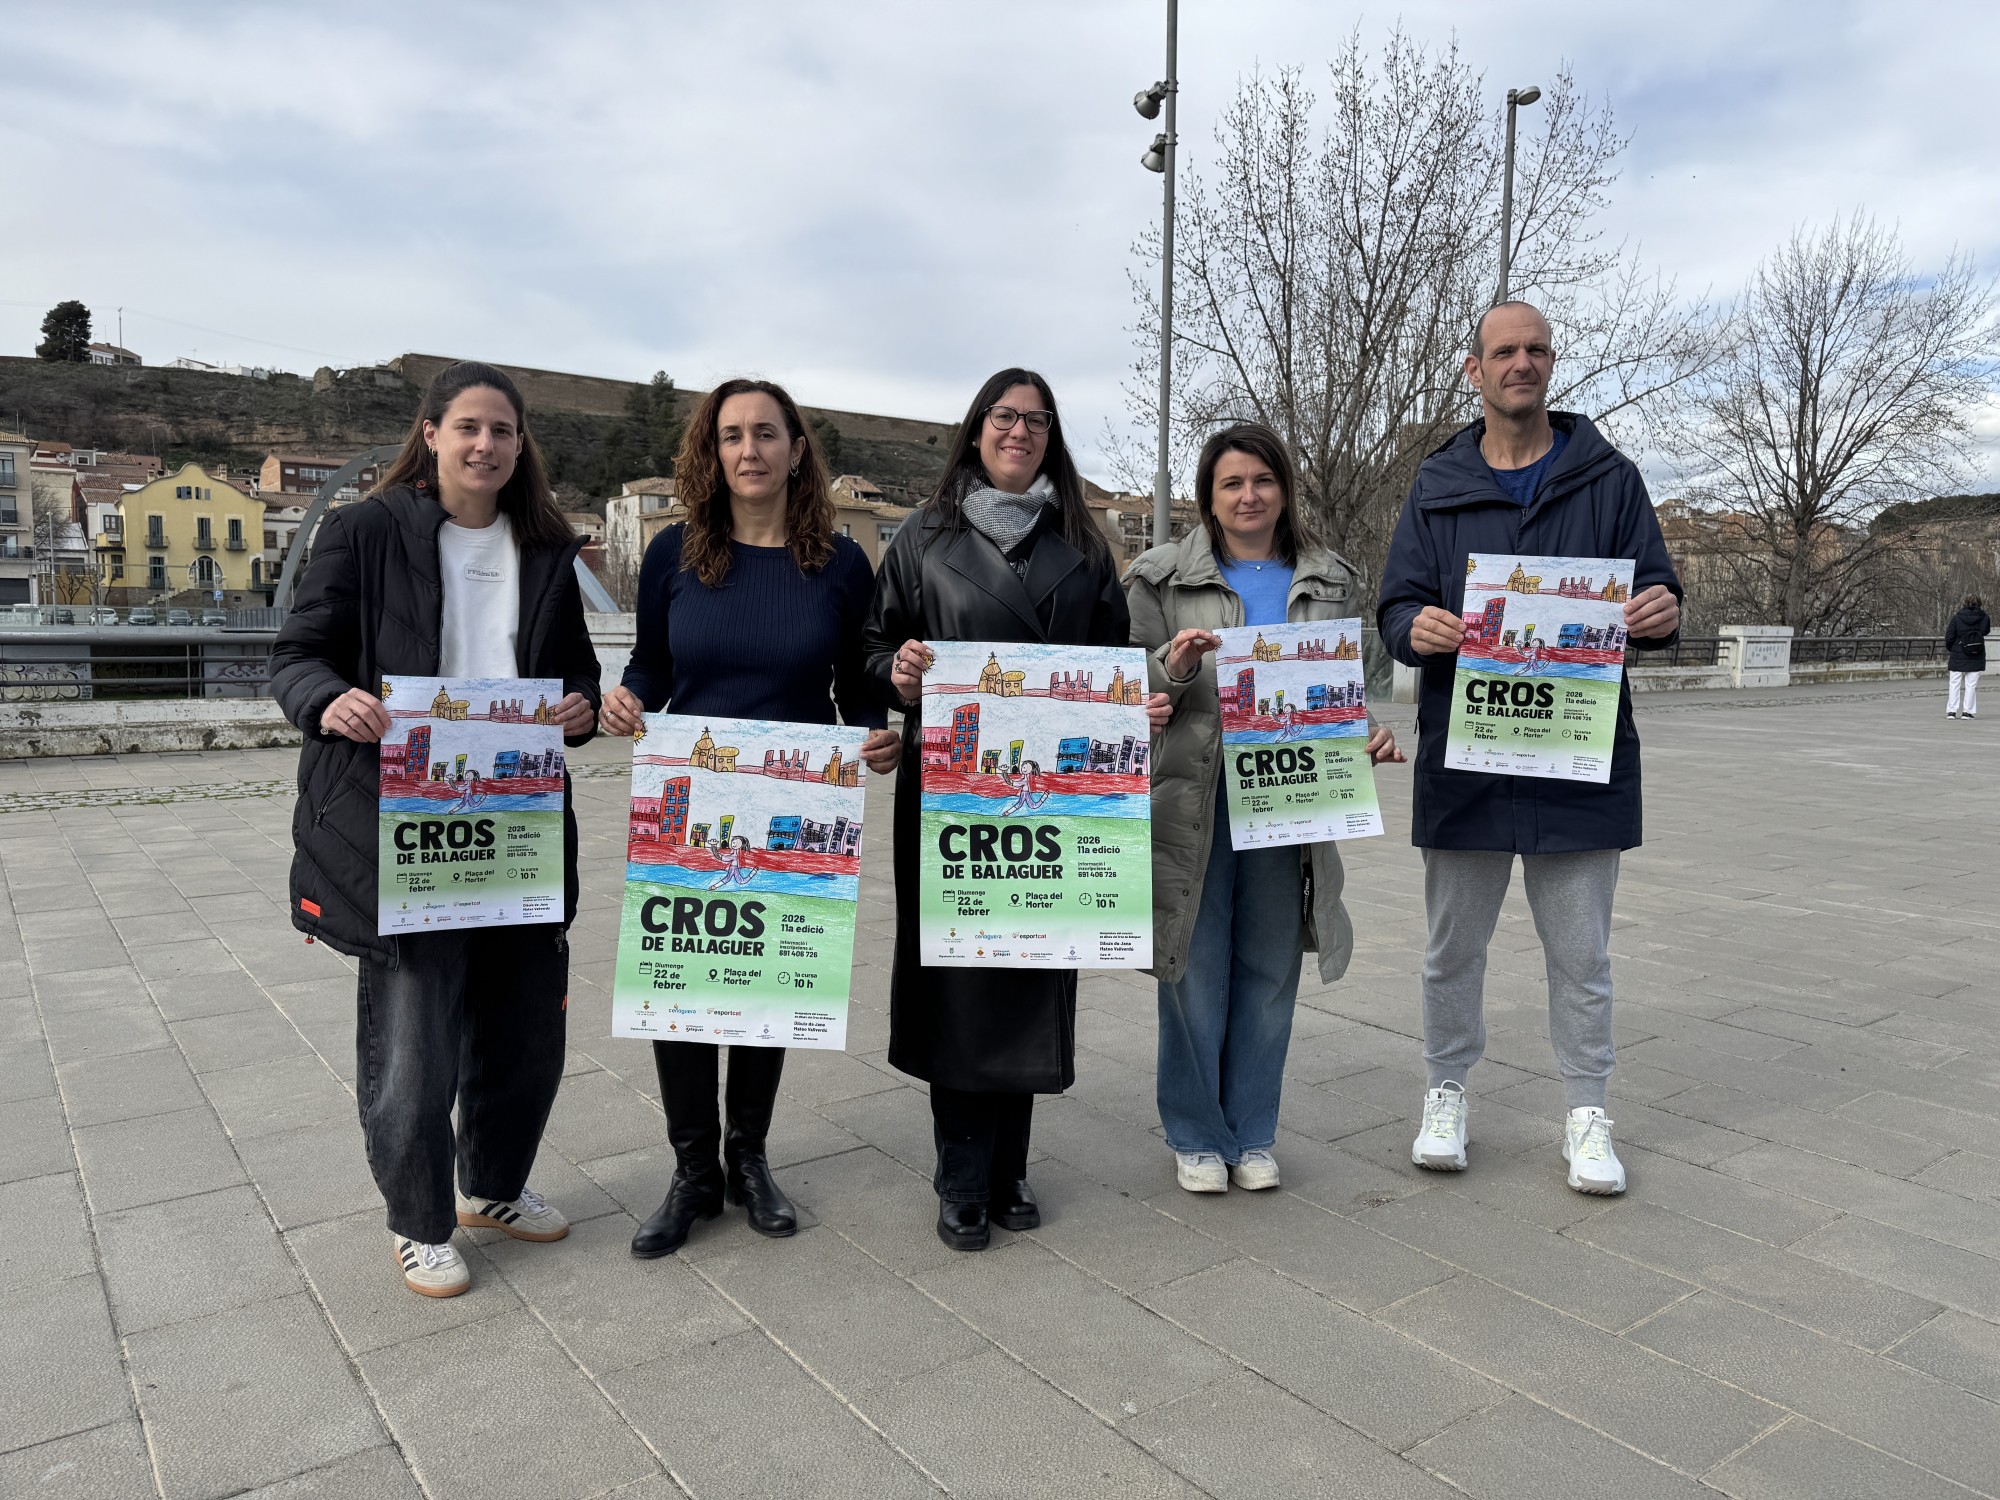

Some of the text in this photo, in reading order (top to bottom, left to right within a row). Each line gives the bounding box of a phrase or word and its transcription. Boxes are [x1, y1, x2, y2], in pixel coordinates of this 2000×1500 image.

[1466, 679, 1556, 708] CROS
[1466, 705, 1553, 719] DE BALAGUER
[1236, 746, 1316, 777] CROS
[1240, 773, 1318, 790] DE BALAGUER
[394, 819, 495, 851] CROS
[1077, 836, 1101, 844] 2026
[938, 824, 1062, 862] CROS
[1077, 846, 1121, 854] 11a edició
[397, 849, 495, 865] DE BALAGUER
[943, 864, 1063, 880] DE BALAGUER
[409, 884, 436, 892] febrer
[958, 896, 970, 905] 22
[1026, 892, 1048, 901] Plaça
[1026, 900, 1053, 908] Morter
[1096, 899, 1116, 908] 10 h
[958, 906, 990, 916] febrer
[640, 896, 767, 938] CROS
[781, 914, 805, 923] 2026
[781, 924, 824, 934] 11a edició
[642, 936, 765, 956] DE BALAGUER
[654, 969, 668, 978] 22
[724, 968, 762, 978] Plaça del
[653, 979, 686, 990] febrer
[723, 977, 751, 986] Morter
[794, 979, 814, 988] 10 h
